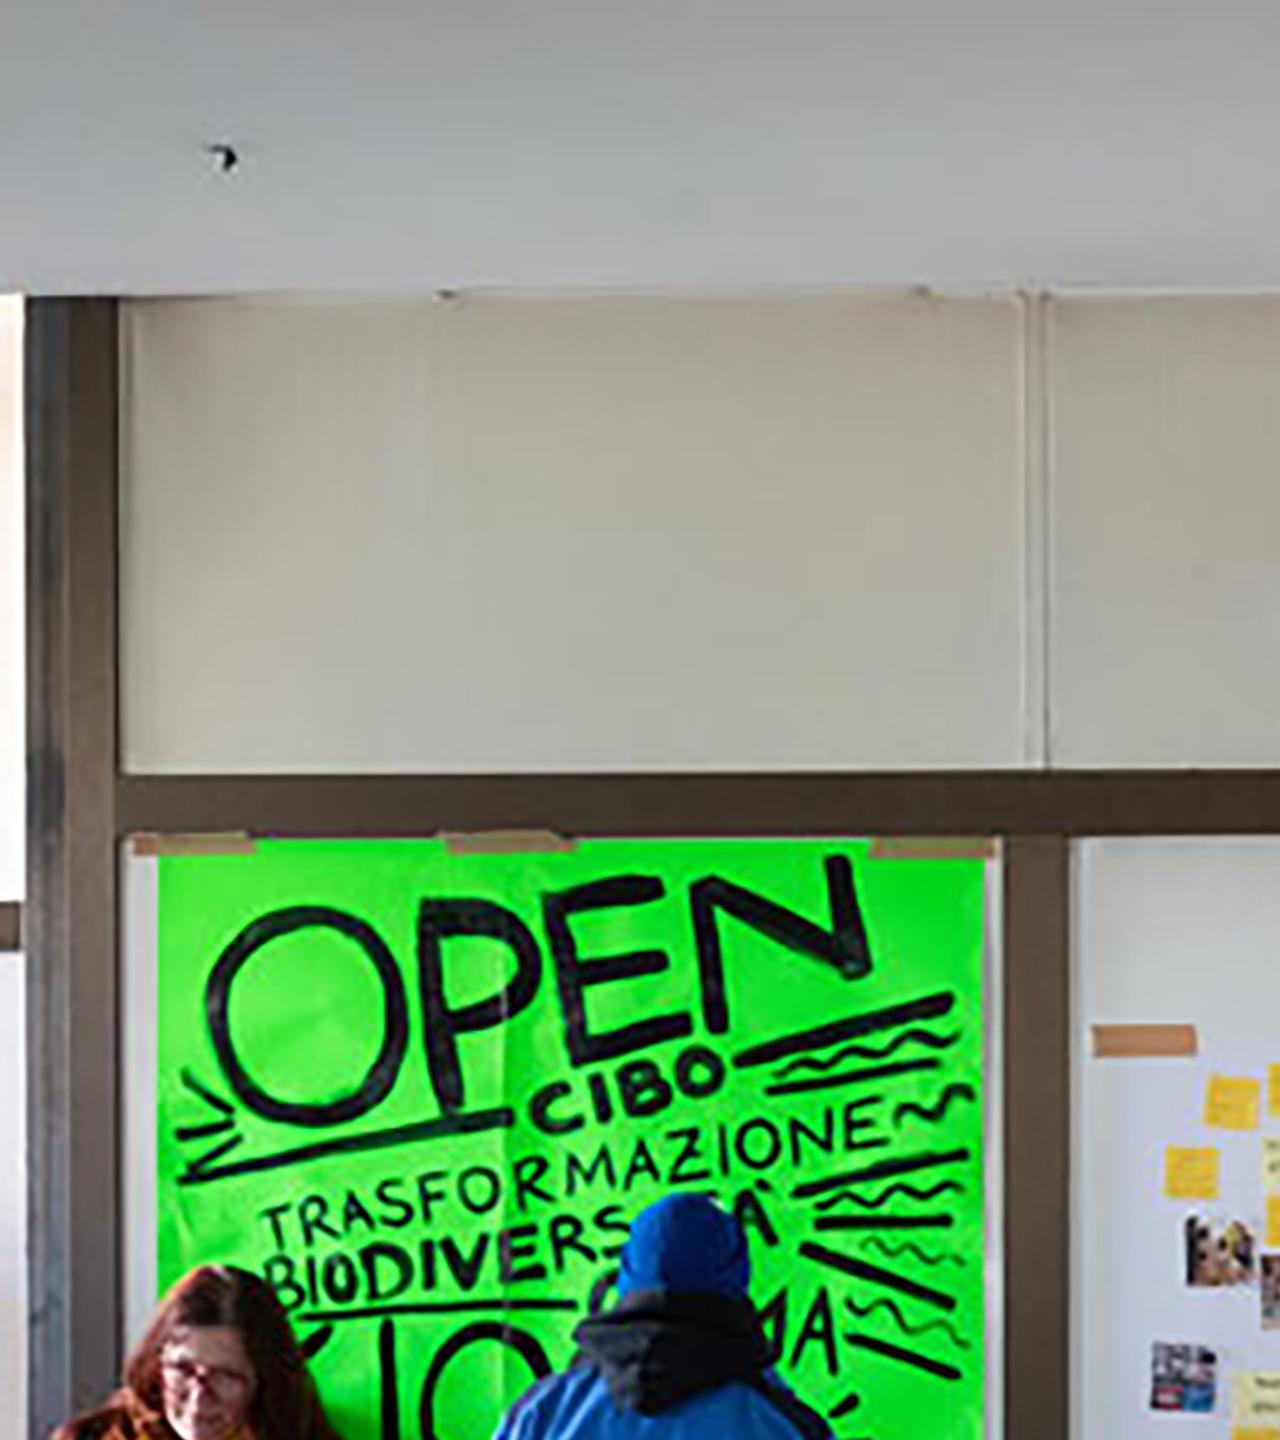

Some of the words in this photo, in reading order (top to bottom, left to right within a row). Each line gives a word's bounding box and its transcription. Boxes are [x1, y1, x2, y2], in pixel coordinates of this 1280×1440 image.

[205, 853, 873, 1127] OPEN
[529, 1046, 726, 1135] CIBO
[259, 1096, 891, 1249] TRASFORMAZIONE
[264, 1178, 780, 1310] BIODIVERSÀ
